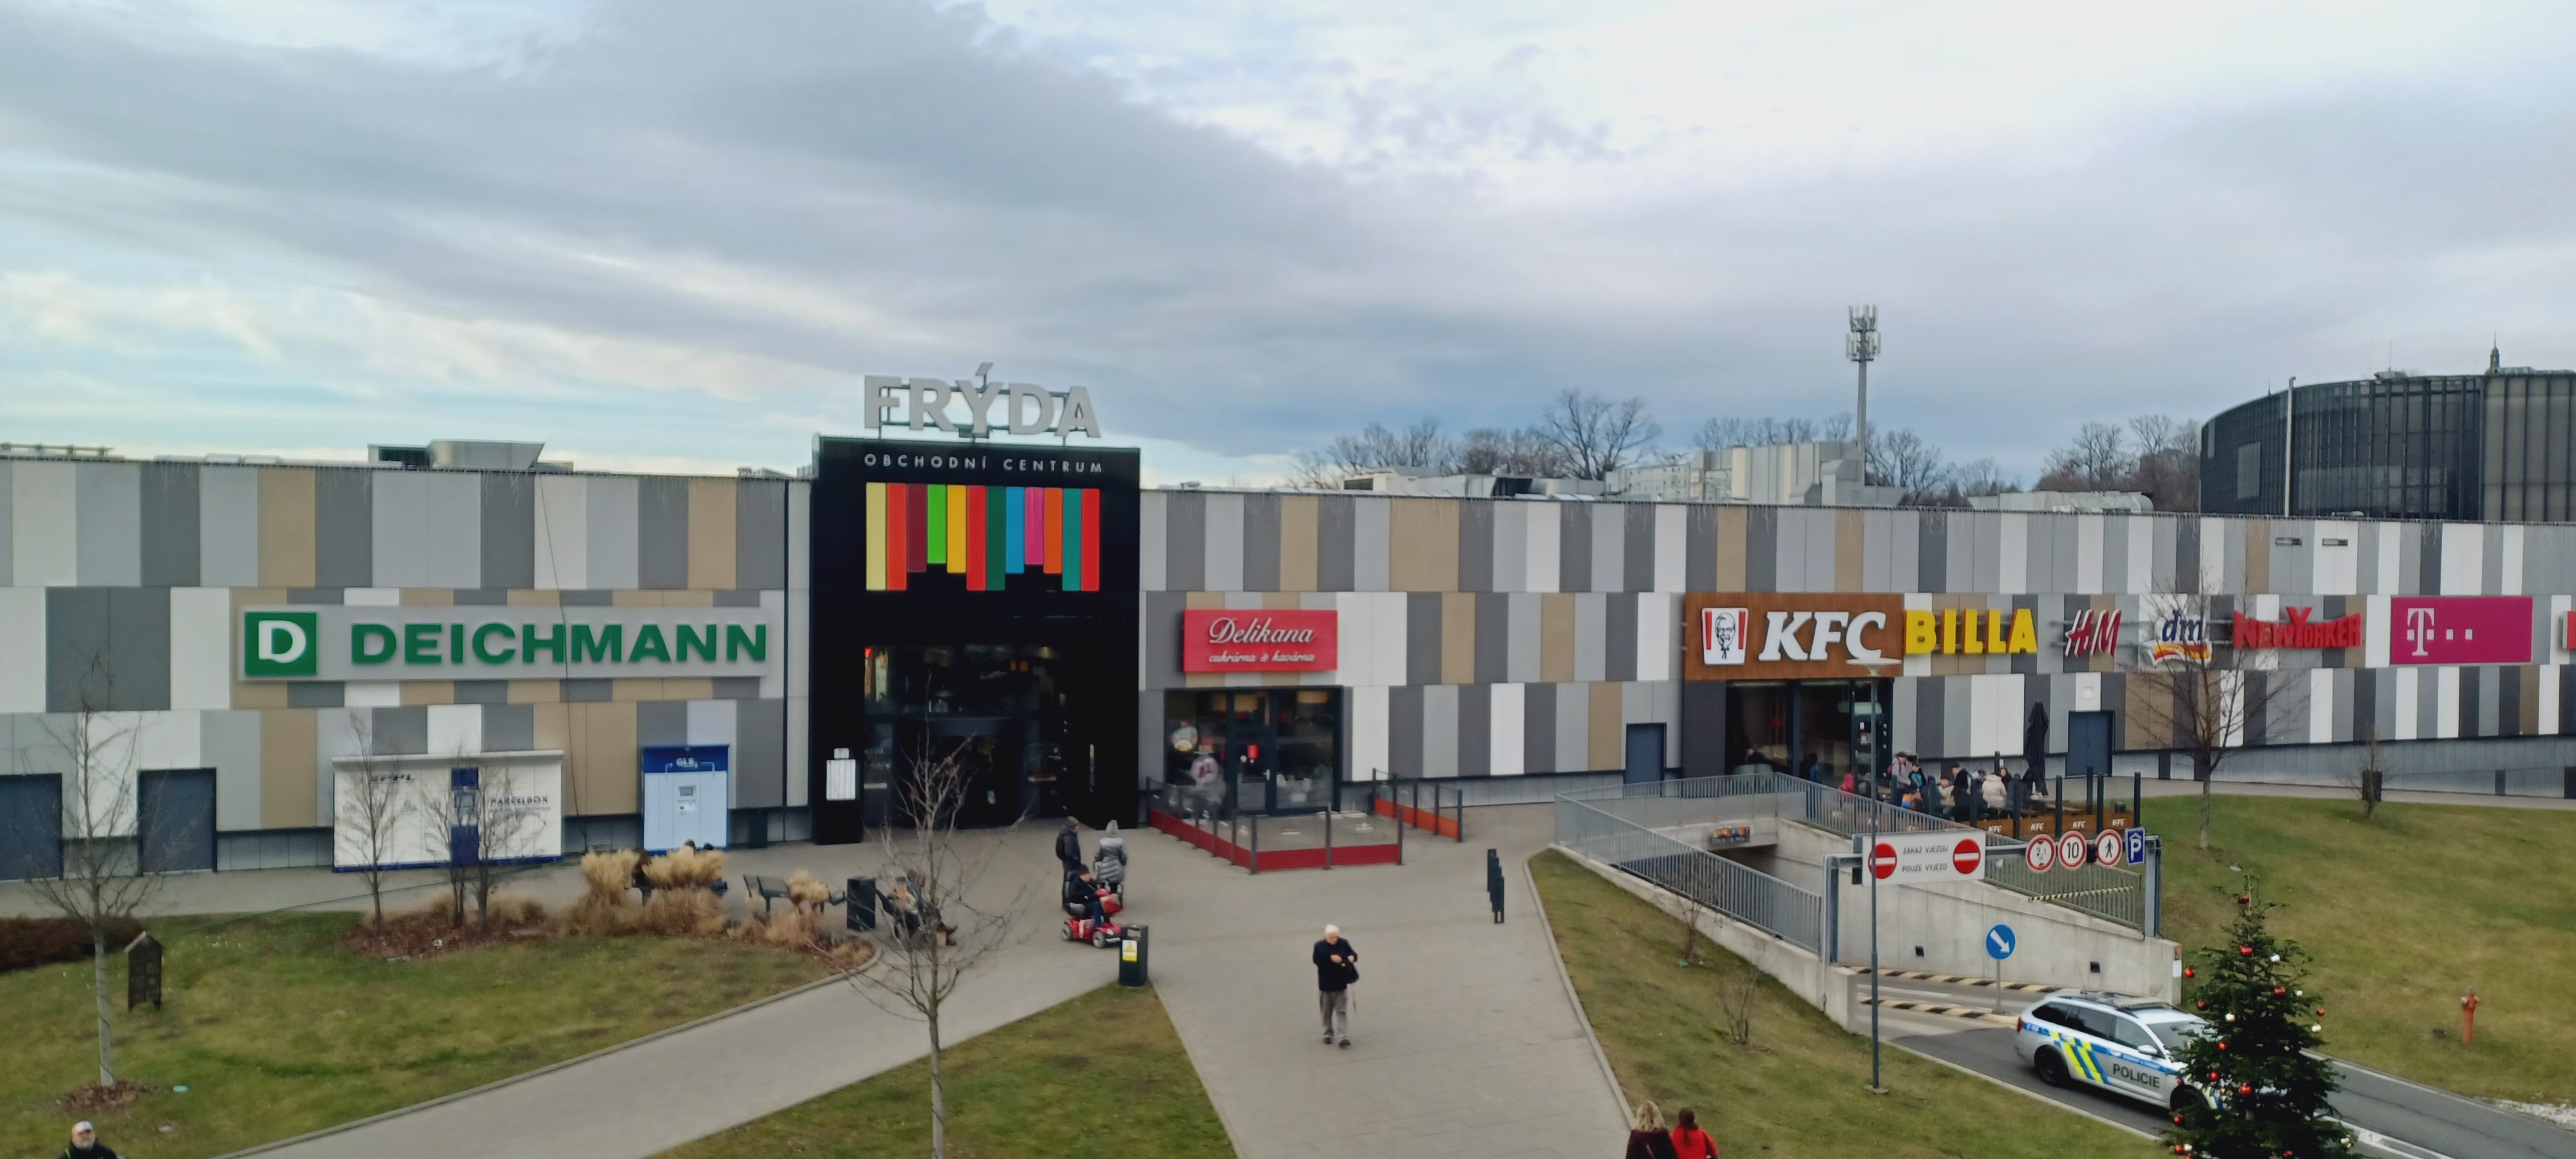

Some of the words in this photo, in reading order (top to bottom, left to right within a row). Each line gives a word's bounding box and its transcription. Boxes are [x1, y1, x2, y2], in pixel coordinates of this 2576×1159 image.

[864, 363, 1101, 438] FRÝDA
[864, 453, 987, 469] OBCHODNÍ
[1003, 458, 1102, 473] CENTRUM
[1209, 617, 1315, 644] Delikana
[1759, 612, 1886, 661] KFC
[1904, 608, 2038, 655] BILLA
[2162, 610, 2203, 643] dm
[258, 620, 307, 663] D
[352, 623, 766, 664] DEICHMANN
[1925, 845, 1949, 853] VJEZDU
[2067, 842, 2079, 858] 10
[2130, 839, 2142, 862] P
[1902, 864, 1922, 872] POUZE
[2113, 1064, 2161, 1088] POLICIE
